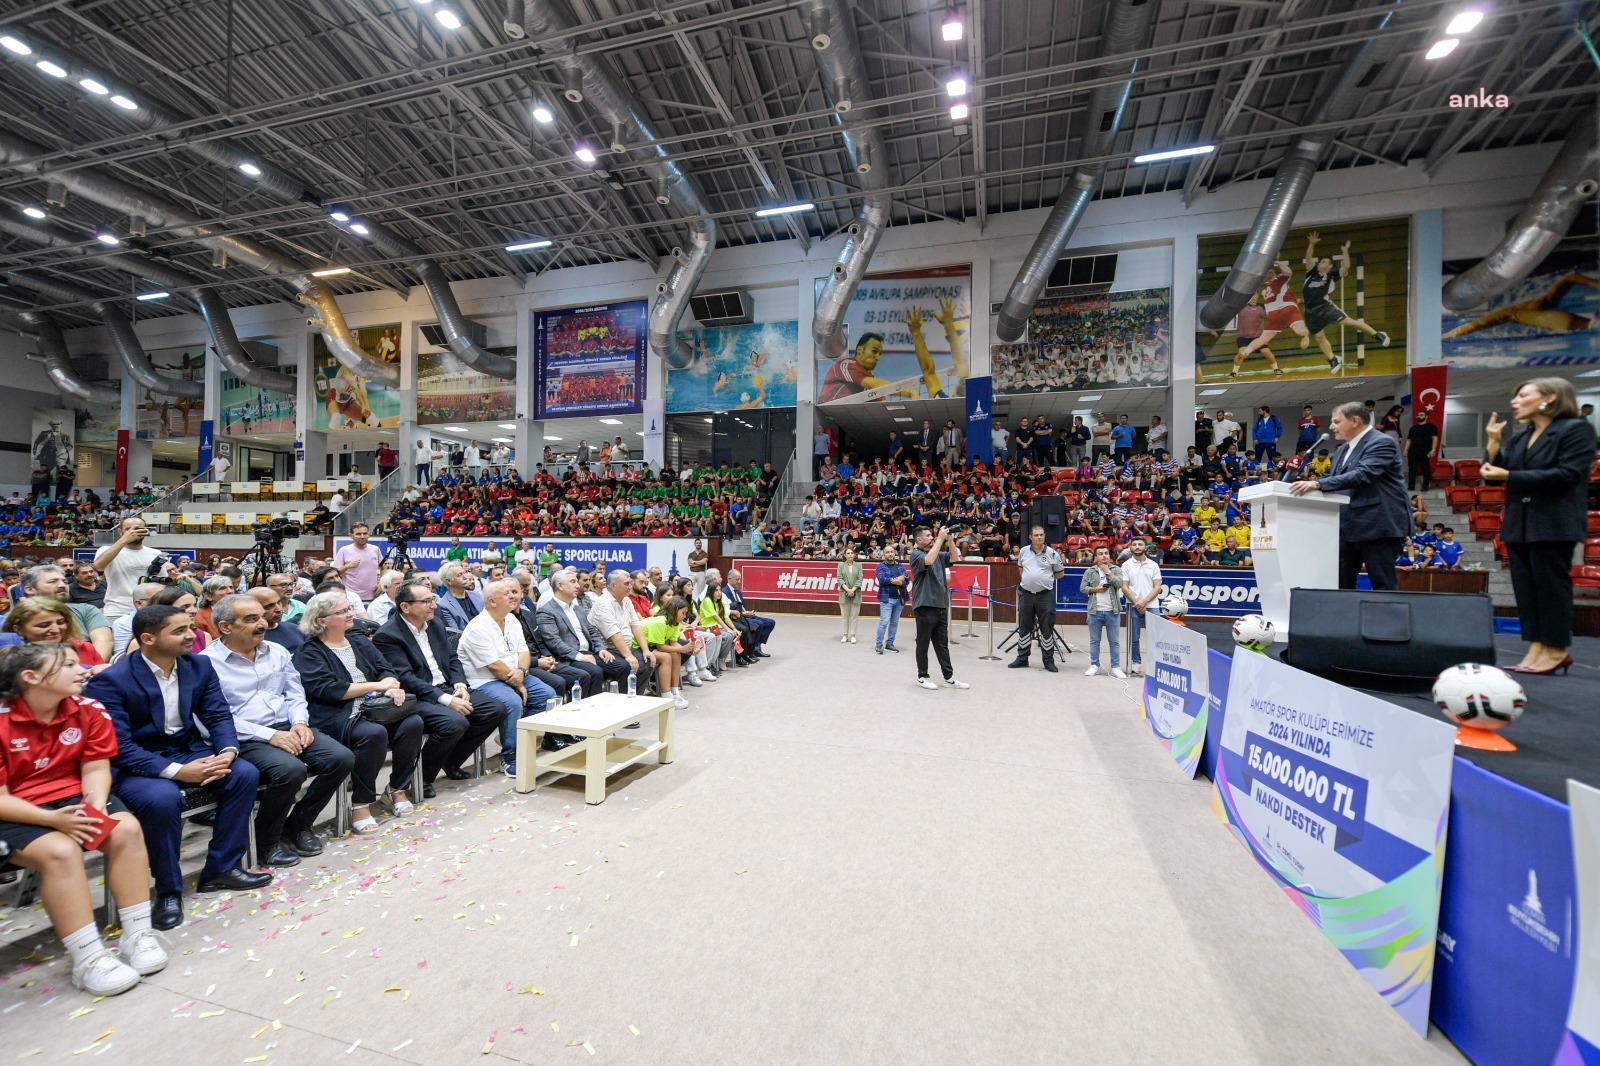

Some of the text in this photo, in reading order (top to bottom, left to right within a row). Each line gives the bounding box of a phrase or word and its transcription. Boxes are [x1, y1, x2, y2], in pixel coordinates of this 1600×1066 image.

[564, 549, 633, 562] SPORCULARA
[1156, 668, 1188, 693] 5.000.000 TL
[1250, 697, 1375, 748] AMATÖR SPOR KULÜPLERİMİZE
[1268, 722, 1331, 758] 2024 YILINDA
[1247, 744, 1356, 820] 15.000.000 TL
[1284, 805, 1326, 844] DESTEK
